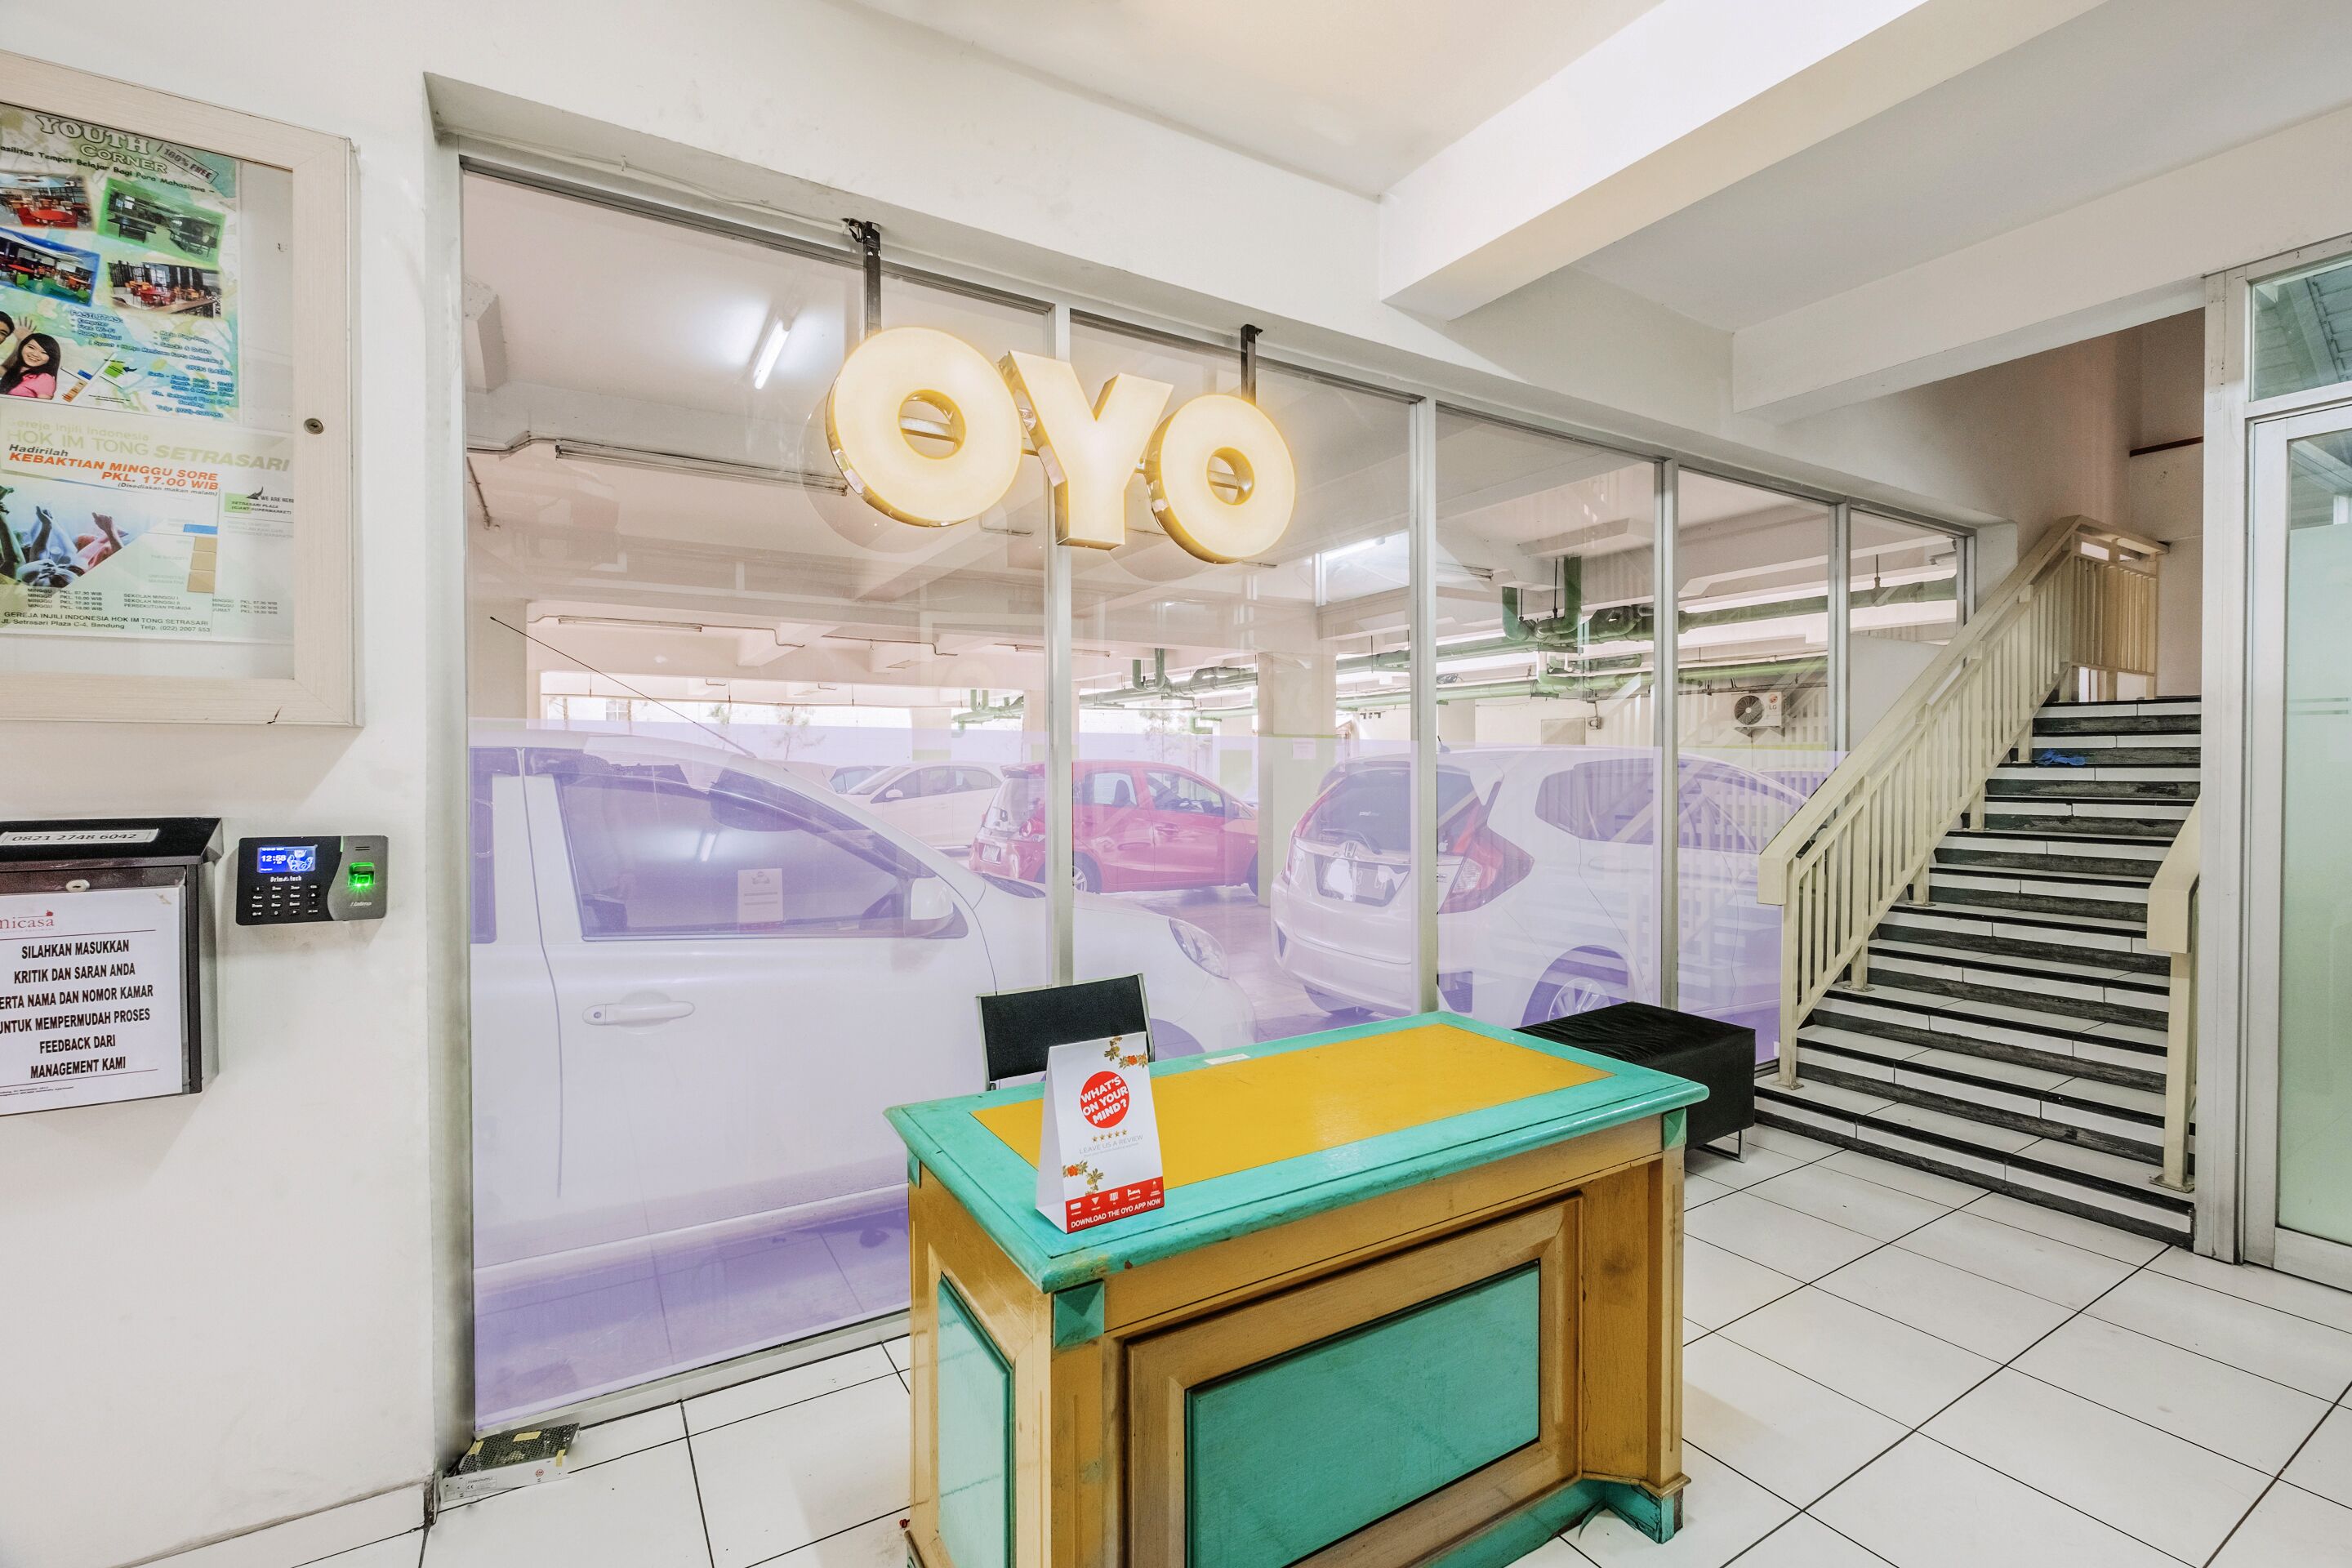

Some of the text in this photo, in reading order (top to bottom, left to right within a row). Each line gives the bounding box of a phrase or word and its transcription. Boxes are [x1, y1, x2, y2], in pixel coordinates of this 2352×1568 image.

[35, 114, 150, 155] YOUTH
[0, 145, 206, 193] asilitas Tempat Belajar Bagi Para Mahasiswa
[80, 144, 167, 174] CORNER
[163, 148, 212, 180] 100% FREE
[56, 423, 82, 434] Injili
[87, 426, 150, 442] Indonesia
[7, 430, 291, 472] HOK IM TONG SETRASARI
[9, 443, 69, 457] Hadirilah
[825, 326, 1296, 565] OYO
[9, 452, 218, 481] KEBAKTIAN MINGGU SORE
[101, 471, 219, 491] PKL. 17.00 WIB
[4, 611, 38, 619] GEREJA
[21, 939, 130, 960] SILAHKAN MASUKKAN
[14, 962, 136, 984] KRITIK DAN SARAN ANDA
[27, 992, 56, 1008] NAMA
[60, 990, 79, 1004] DAN
[82, 987, 118, 1003] NOMOR
[120, 984, 154, 999] KAMAR
[35, 1011, 111, 1031] MEMPERMUDAH
[114, 1008, 150, 1023] PROSES
[39, 1034, 116, 1054] FEEDBACK DARI
[30, 1056, 127, 1079] MANAGEMENT KAMI
[1080, 1076, 1121, 1103] WHAT'S
[1082, 1085, 1128, 1116] ON YOUR
[1092, 1098, 1127, 1125] MIND?
[1079, 1144, 1101, 1154] LEAVE
[1119, 1134, 1143, 1145] REVIEW
[1071, 1214, 1107, 1228] DOWNLOAD
[1107, 1208, 1120, 1218] THE
[1120, 1204, 1134, 1214] OYO
[1134, 1200, 1147, 1211] APP
[1147, 1197, 1161, 1208] NOW
